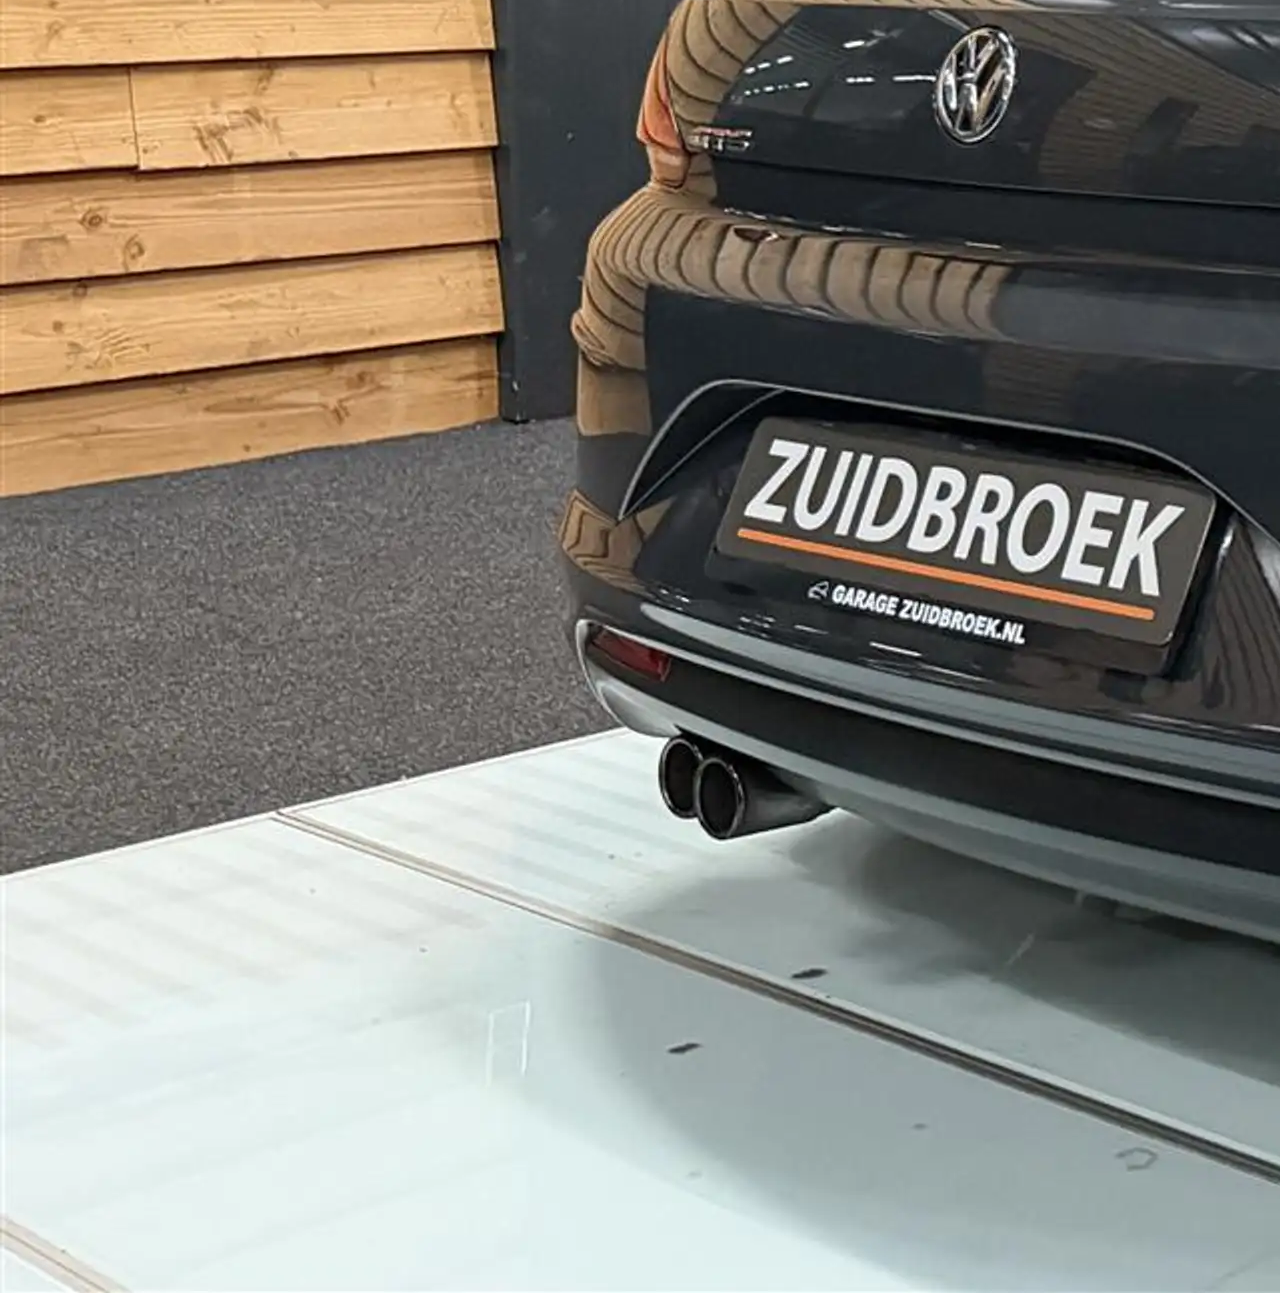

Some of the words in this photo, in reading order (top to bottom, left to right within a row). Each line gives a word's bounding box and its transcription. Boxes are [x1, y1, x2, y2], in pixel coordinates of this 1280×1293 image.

[743, 438, 1185, 597] ZUIDBROEK
[832, 585, 899, 617] GARAGE
[899, 598, 1027, 645] ZUIDBROEK.NL
